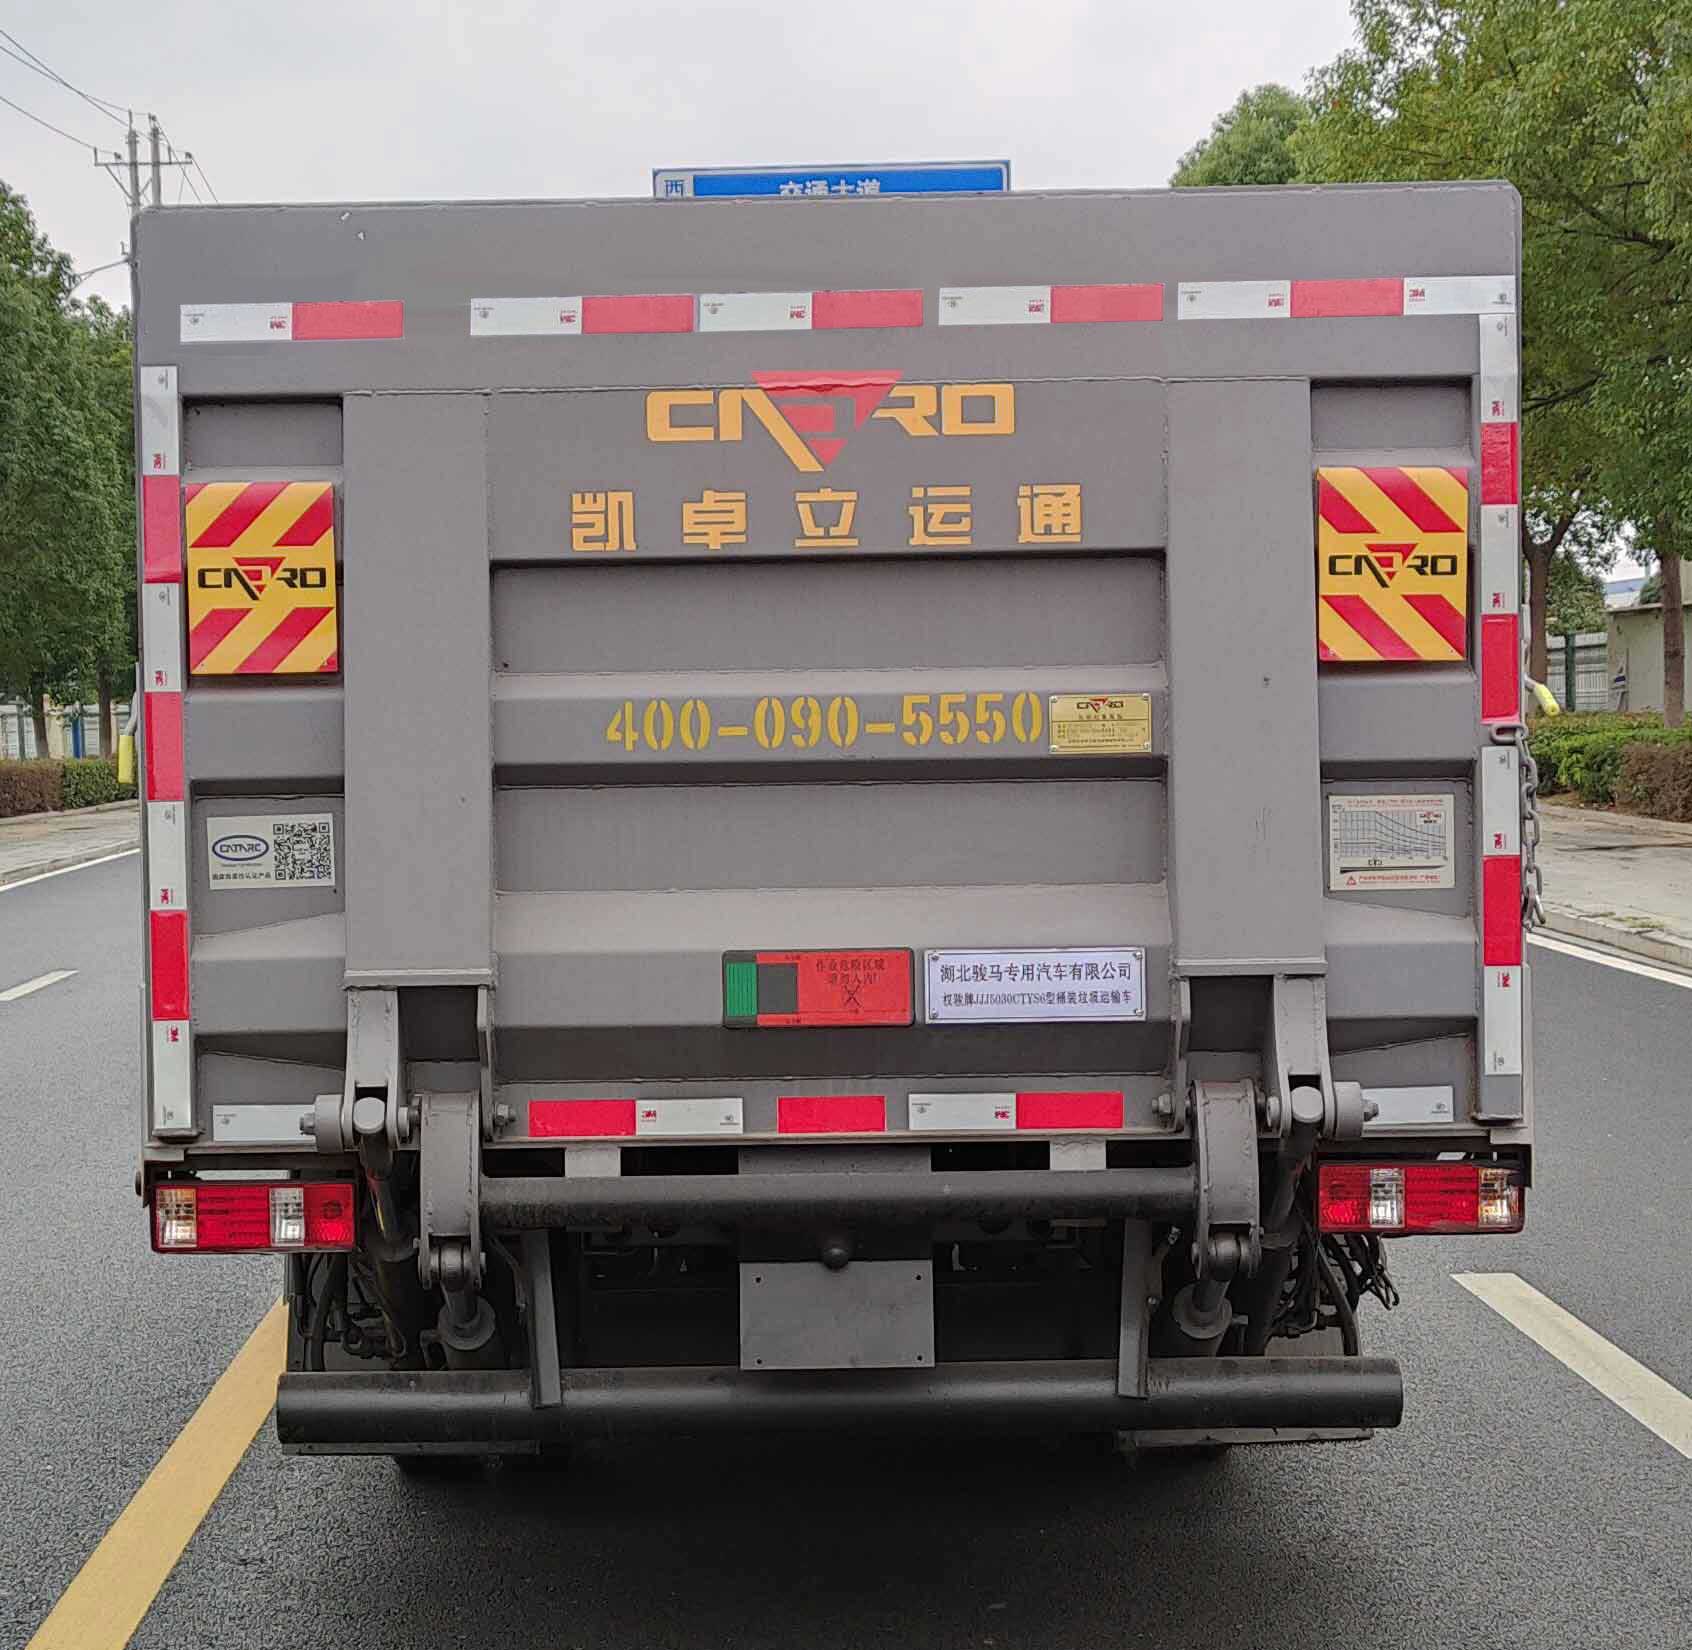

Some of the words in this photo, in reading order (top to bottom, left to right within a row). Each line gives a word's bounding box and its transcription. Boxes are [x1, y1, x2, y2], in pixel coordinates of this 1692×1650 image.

[570, 483, 1082, 552] 凯卓立运通
[605, 691, 1043, 751] 400-090-5550
[939, 962, 1132, 983] 湖北骏马专用汽车有限公司
